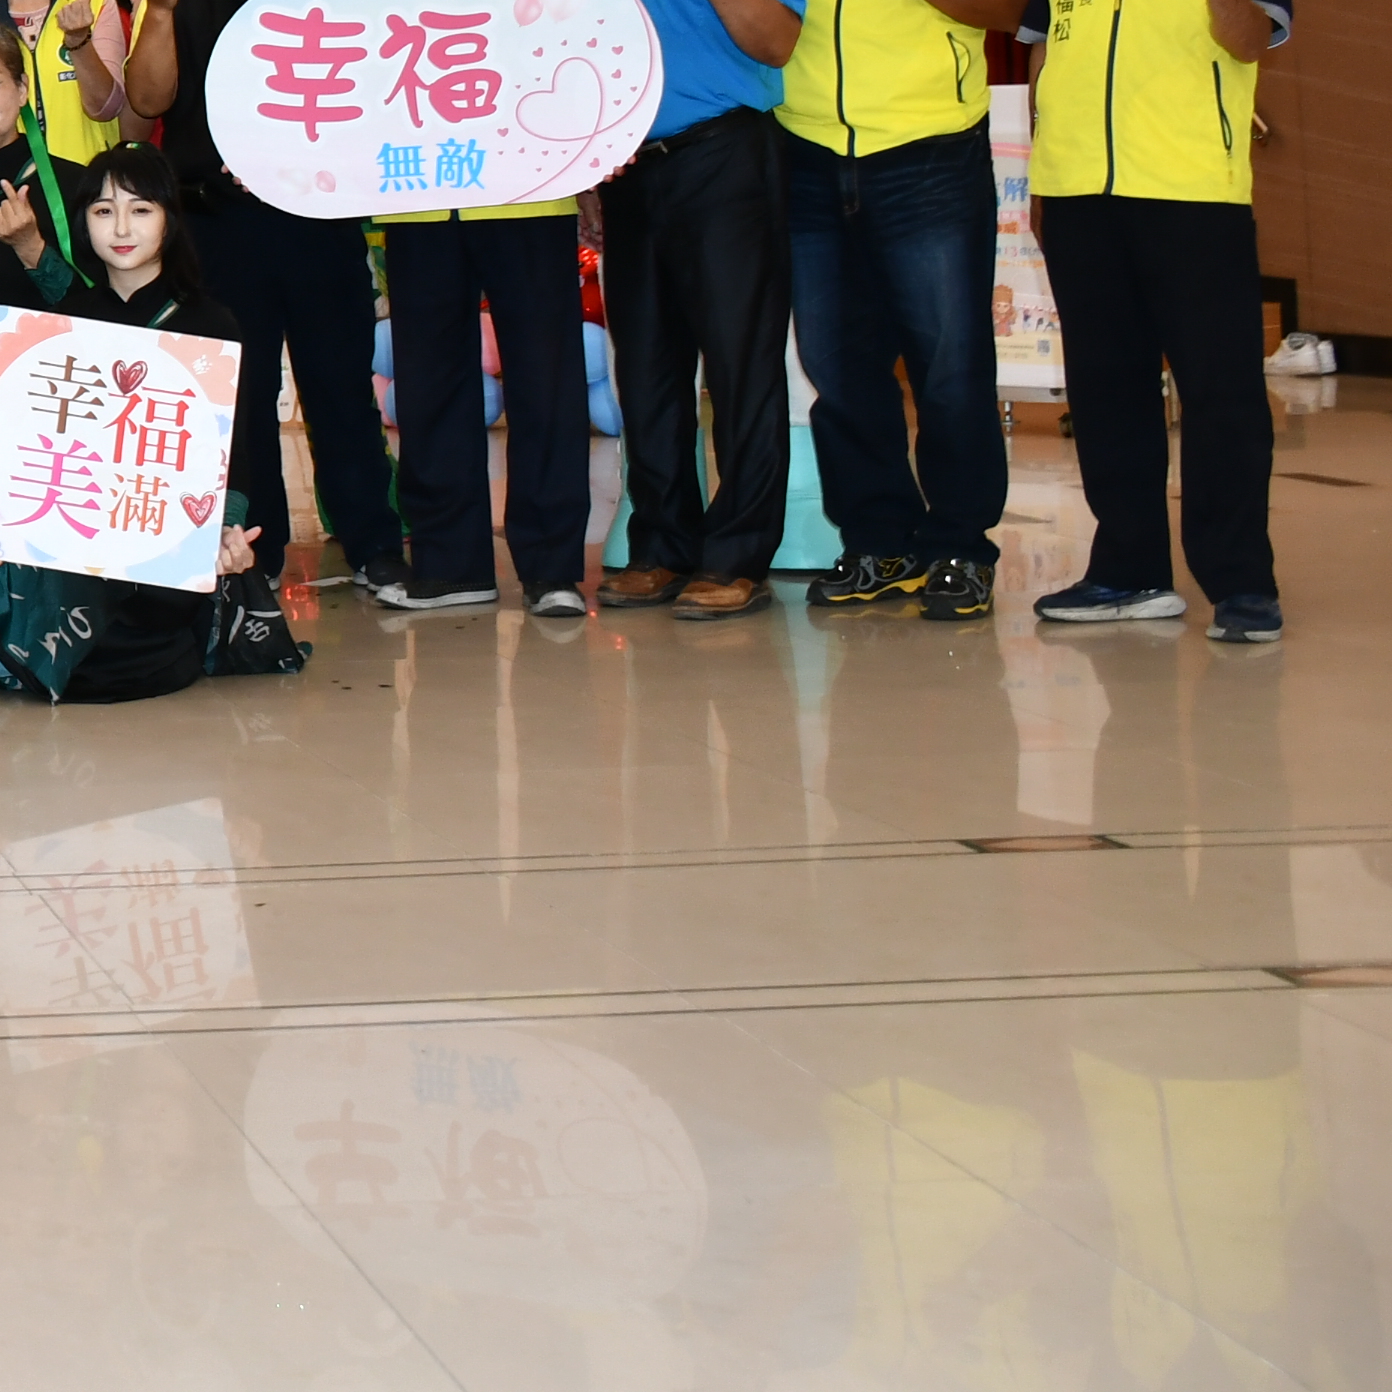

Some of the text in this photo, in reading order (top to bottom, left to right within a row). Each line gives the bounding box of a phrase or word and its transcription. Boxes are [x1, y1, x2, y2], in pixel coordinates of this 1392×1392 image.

[251, 7, 503, 142] 幸福
[376, 138, 487, 193] 無敵
[28, 355, 197, 472] 幸福
[2, 433, 171, 540] 美滿
